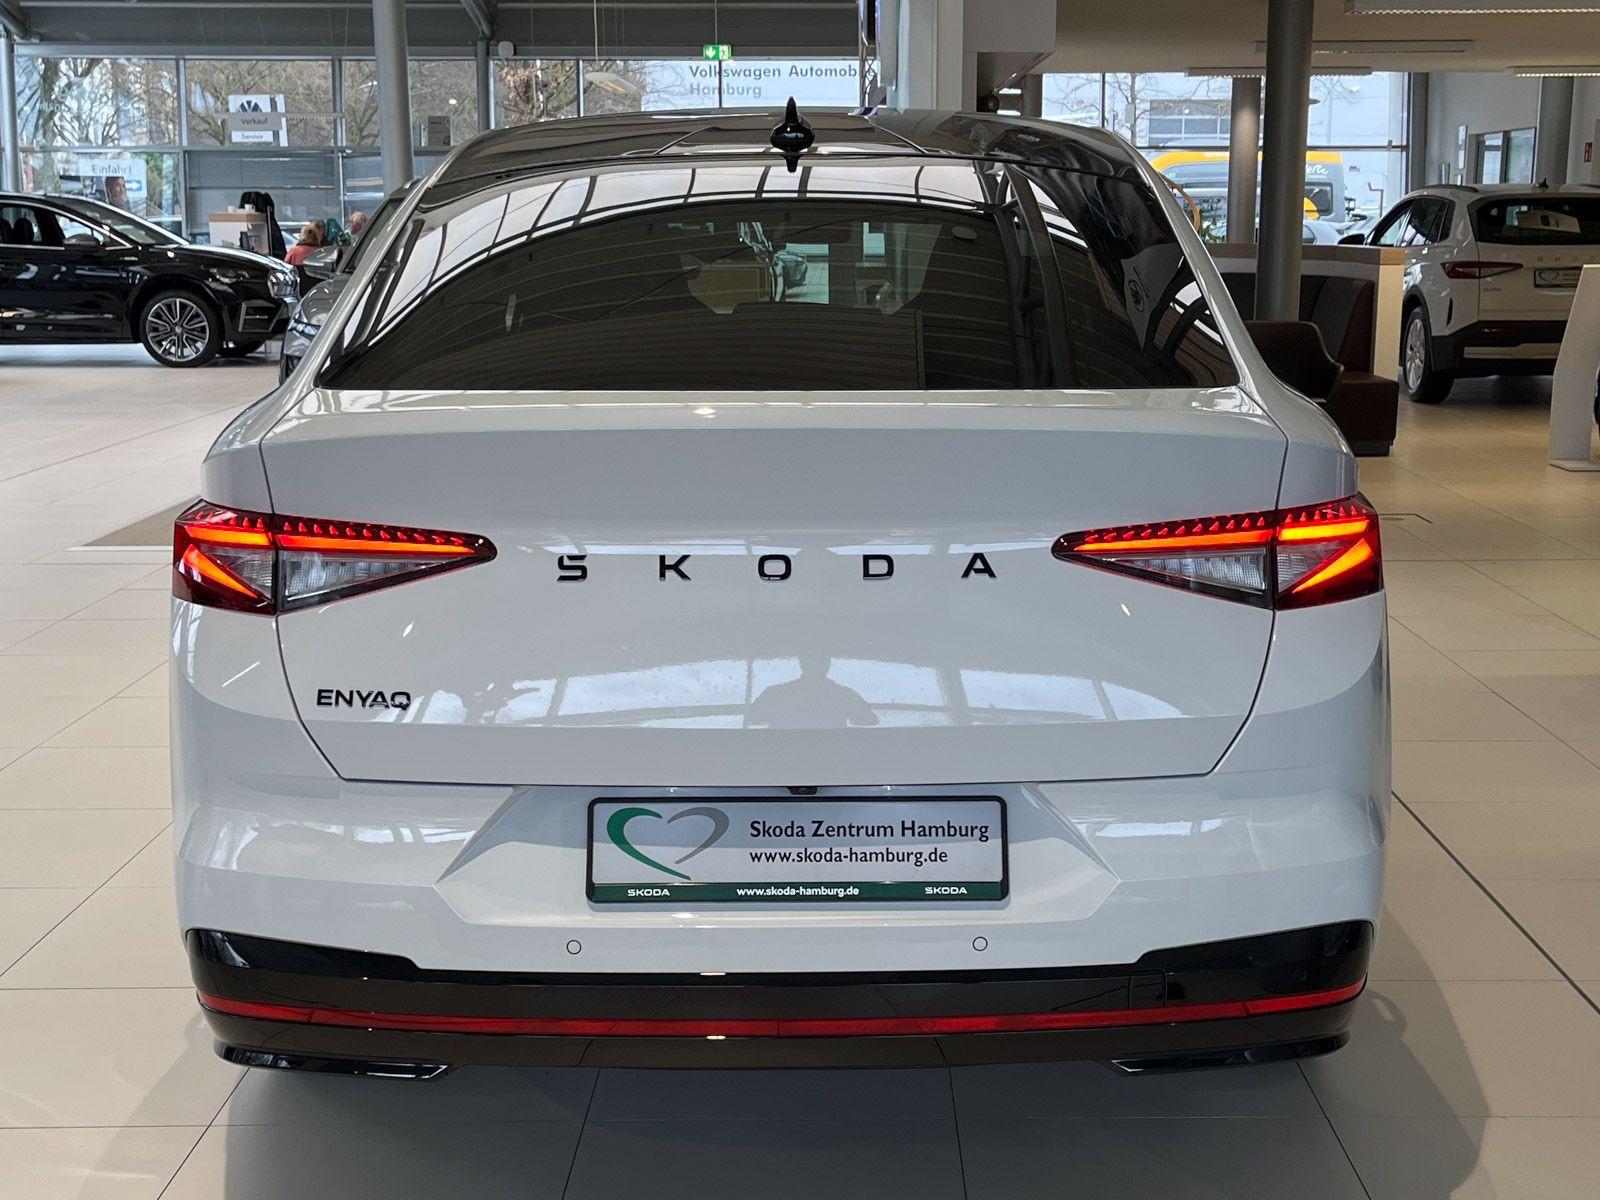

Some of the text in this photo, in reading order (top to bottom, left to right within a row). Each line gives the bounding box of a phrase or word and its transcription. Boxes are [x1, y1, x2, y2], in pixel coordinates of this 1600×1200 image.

[689, 65, 857, 80] Volkswagen Automob
[241, 117, 268, 125] Verkauf
[91, 164, 132, 175] Einfahrt
[316, 688, 411, 710] ENYAQ
[749, 820, 989, 842] Skoda Zentrum Hamburg
[749, 848, 948, 867] www.skoda-hamburg.de
[736, 886, 860, 898] www.skoda-hamburg.de
